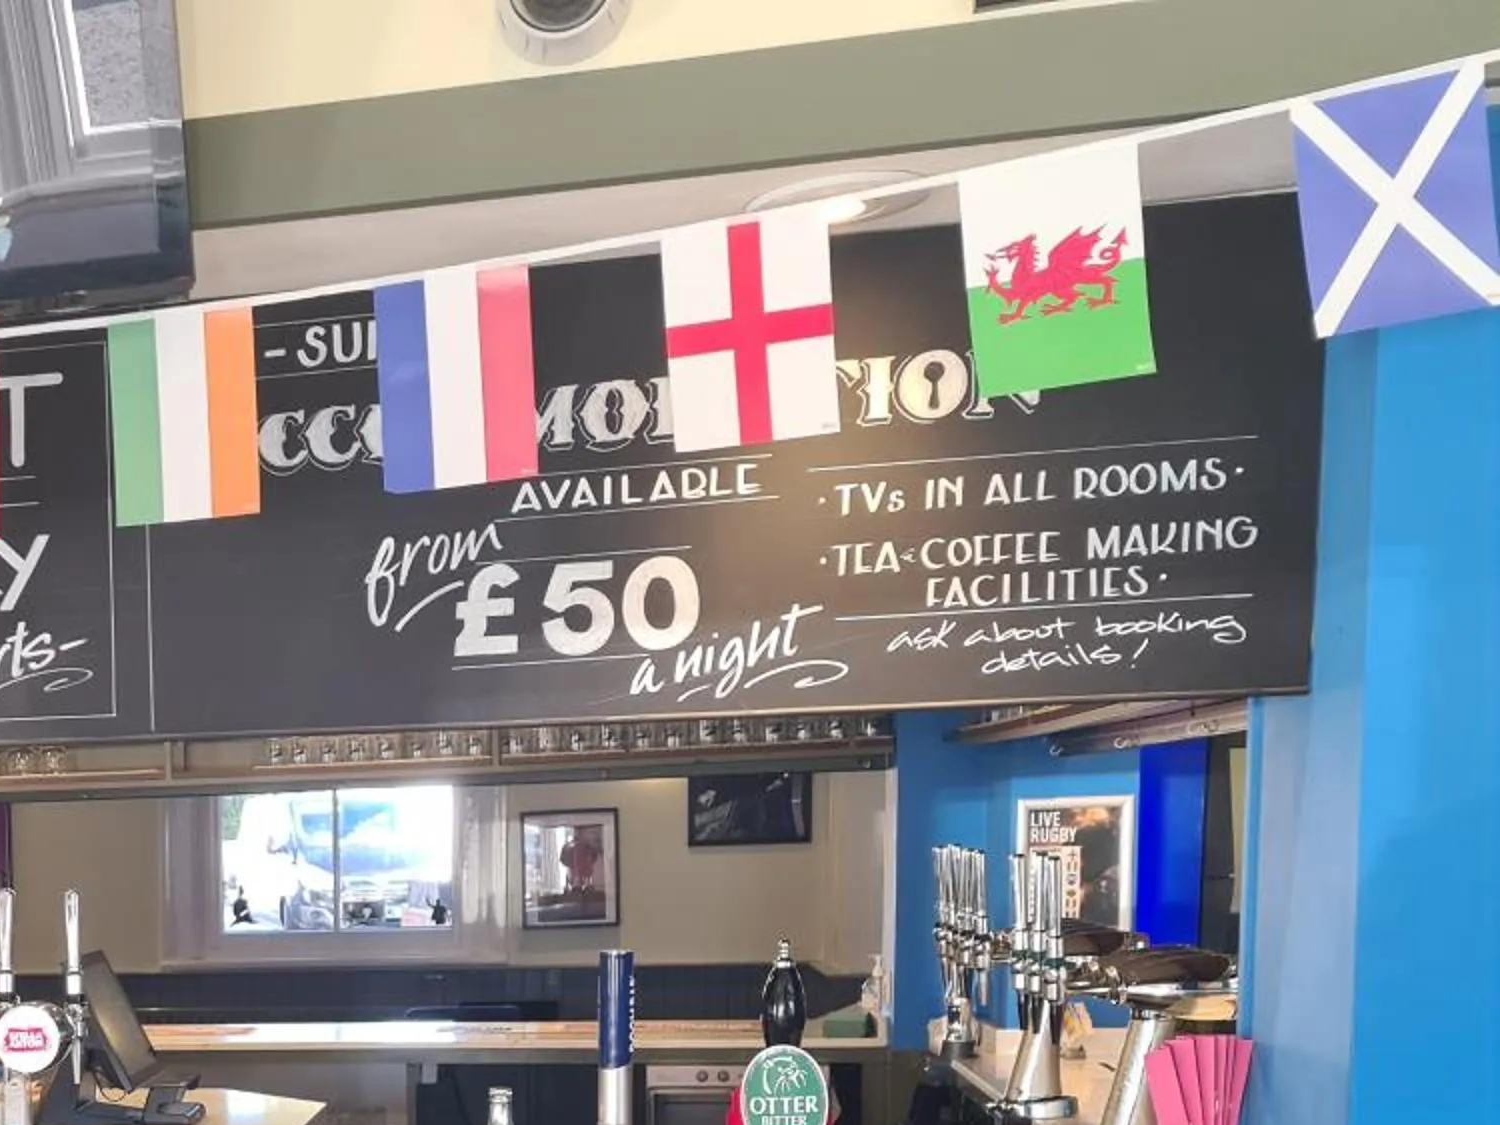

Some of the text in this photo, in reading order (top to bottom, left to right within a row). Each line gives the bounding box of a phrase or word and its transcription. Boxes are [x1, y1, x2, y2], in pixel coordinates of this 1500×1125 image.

[511, 463, 763, 514] AVAILABLE
[835, 481, 906, 517] TVs
[924, 475, 966, 512] IN
[984, 469, 1057, 507] ALL
[1086, 515, 1259, 561] MAKING
[364, 519, 504, 628] from
[453, 554, 701, 658] £50
[629, 602, 825, 700] a night
[886, 610, 1248, 653] ask about booking
[1030, 811, 1061, 828] LIVE
[1030, 826, 1078, 843] RUGBY
[749, 1095, 819, 1115] OTTER
